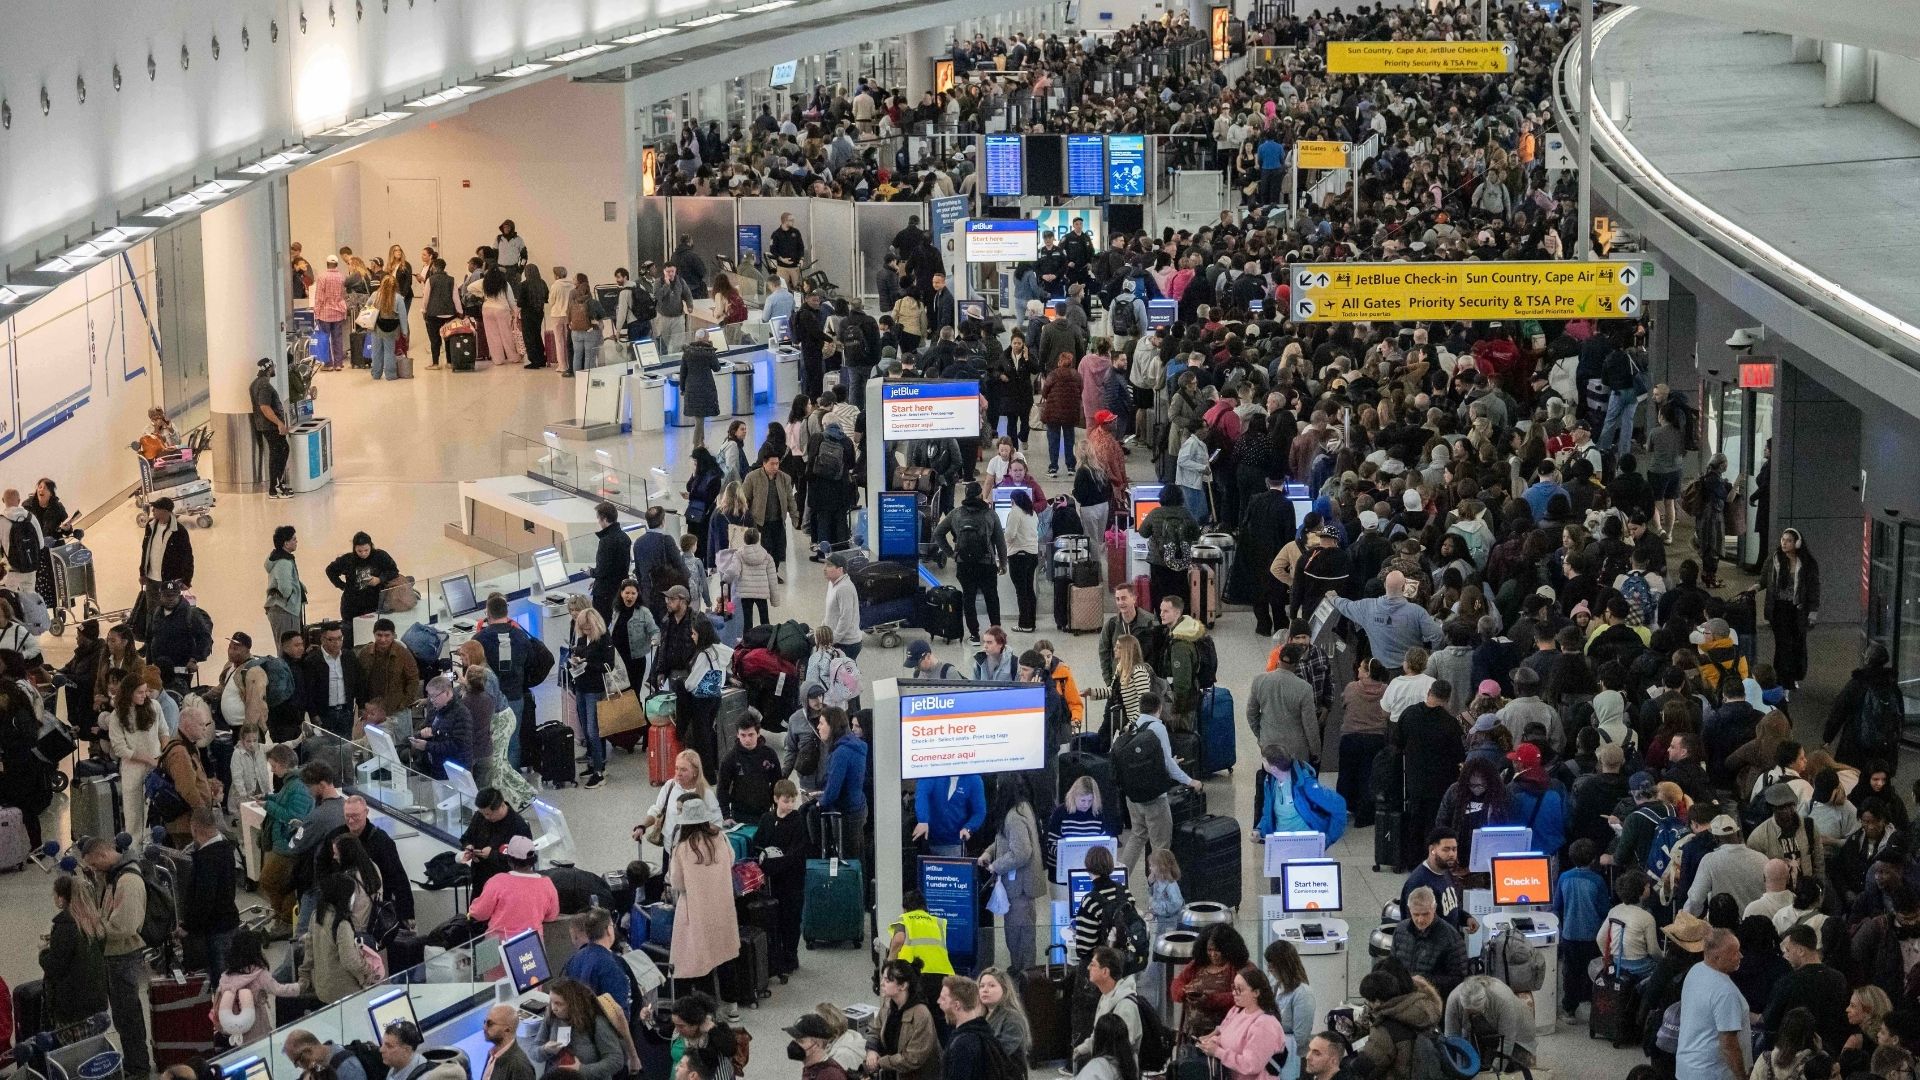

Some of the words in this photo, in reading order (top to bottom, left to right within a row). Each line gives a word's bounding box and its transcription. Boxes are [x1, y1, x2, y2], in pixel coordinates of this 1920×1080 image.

[1363, 47, 1394, 55] Country,
[1396, 47, 1414, 55] Cape
[1416, 47, 1429, 55] Air,
[1384, 60, 1411, 68] Priority
[1412, 60, 1441, 68] Security
[1355, 274, 1400, 285] JetBlue
[1404, 272, 1458, 284] Check-in
[1466, 272, 1488, 284] Sun
[1491, 272, 1542, 285] Country,
[1545, 271, 1574, 285] Cape
[1577, 271, 1595, 282] Air
[1341, 298, 1359, 309] All
[1364, 298, 1401, 309] Gates
[1409, 297, 1455, 310] Priority
[1459, 296, 1509, 310] Security
[1514, 296, 1522, 307] &
[1526, 295, 1550, 307] TSA
[1555, 295, 1575, 306] Pre
[891, 387, 919, 398] jetBlue
[891, 405, 913, 413] Start
[911, 697, 955, 714] jetBlue
[912, 724, 945, 737] Start
[948, 724, 976, 735] here
[911, 752, 955, 762] Comenzar
[957, 750, 976, 760] aquí
[926, 874, 960, 882] Remember,
[1503, 877, 1530, 887] Check
[1531, 877, 1541, 885] in.
